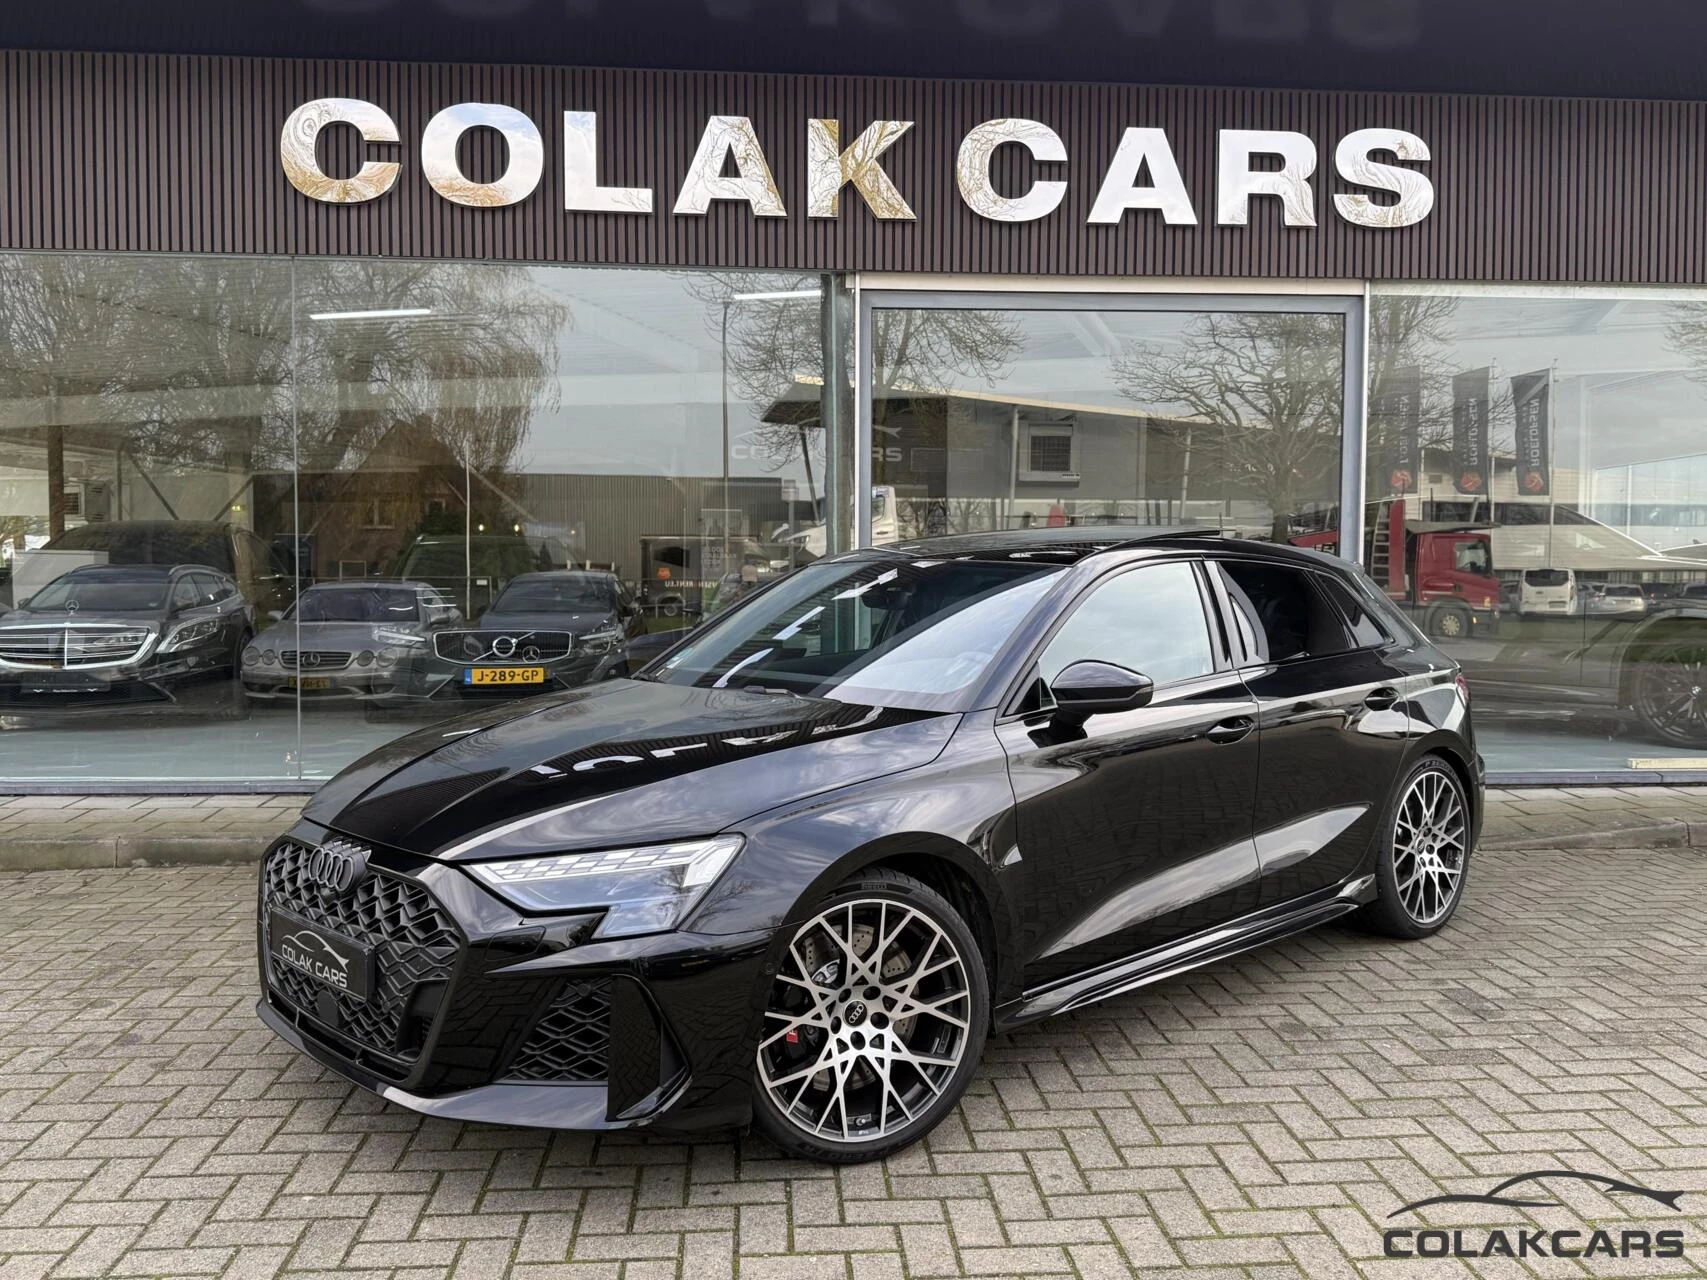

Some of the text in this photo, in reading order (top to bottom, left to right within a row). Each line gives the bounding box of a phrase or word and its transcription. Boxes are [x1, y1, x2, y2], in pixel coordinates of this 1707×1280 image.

[279, 97, 1434, 230] COLAK CARS
[477, 669, 539, 682] J-289-GP
[281, 943, 348, 988] COLAK CARS
